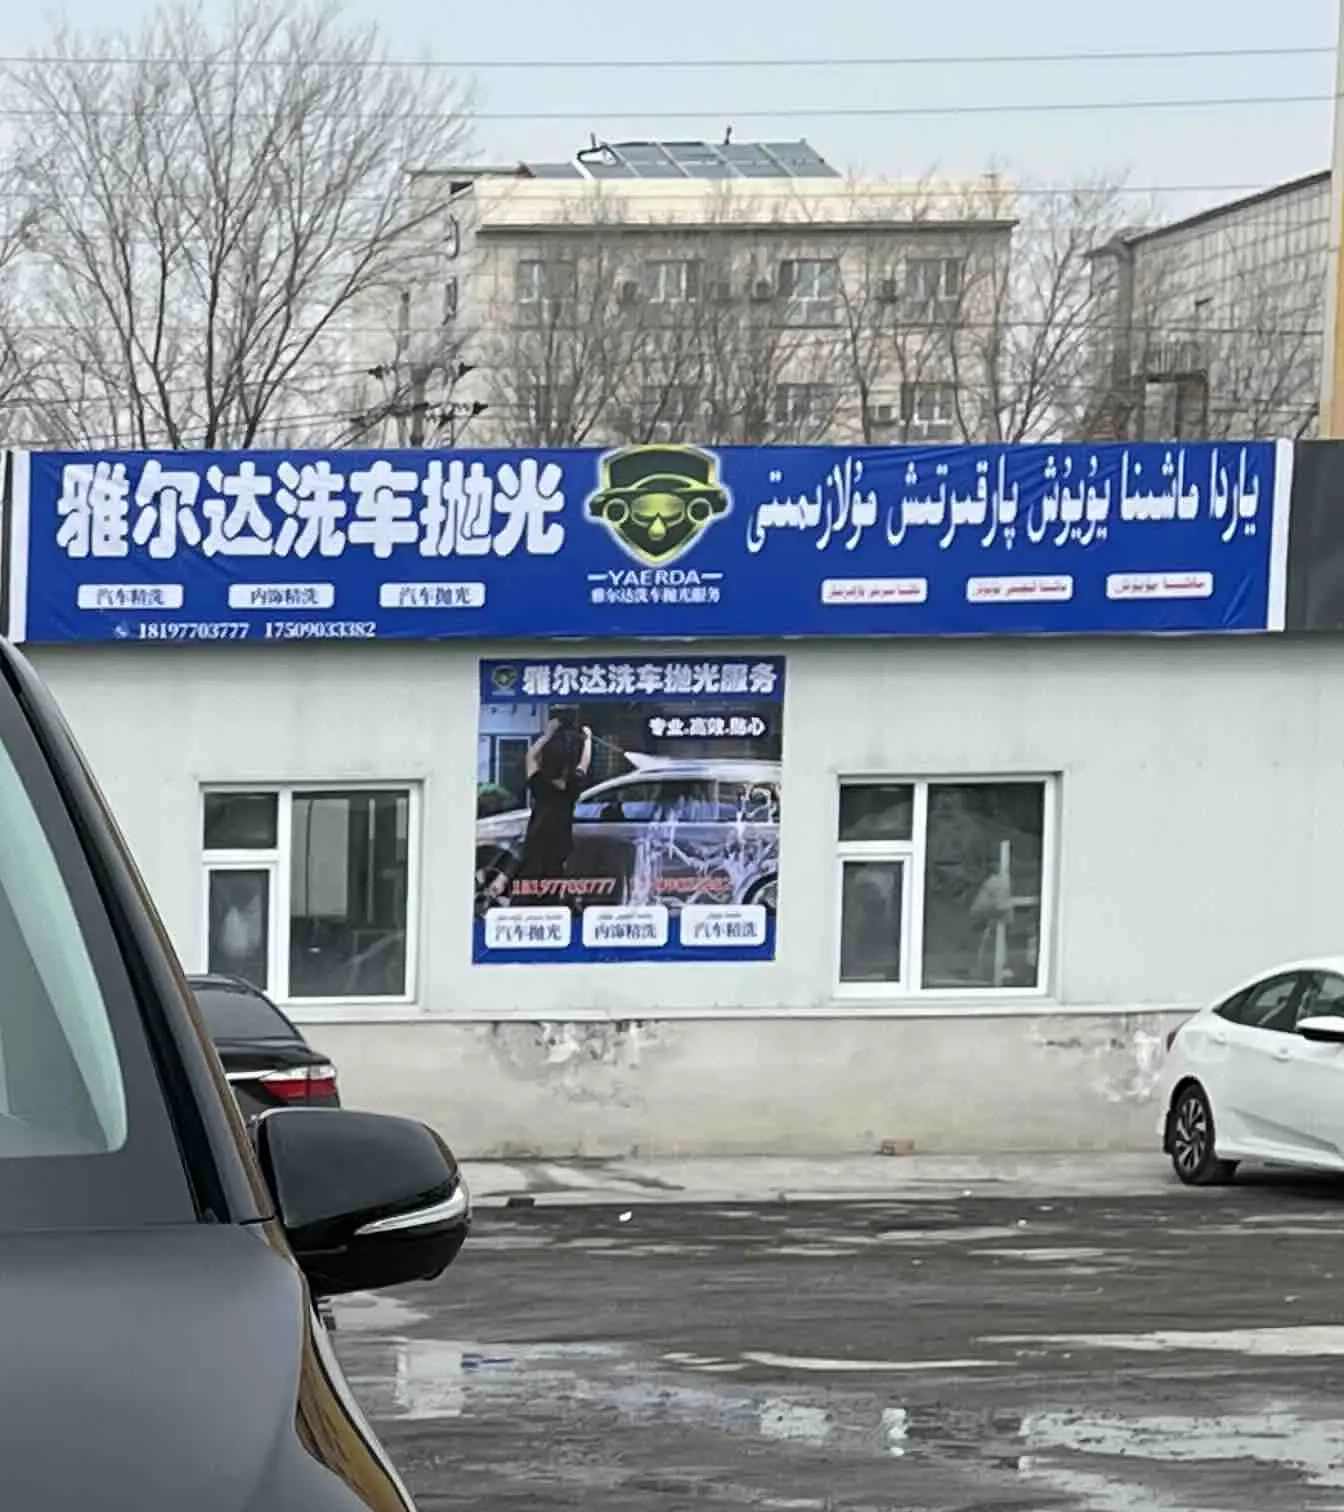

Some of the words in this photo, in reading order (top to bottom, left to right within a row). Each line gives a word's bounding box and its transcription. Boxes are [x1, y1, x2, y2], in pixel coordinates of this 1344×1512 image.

[56, 458, 564, 559] 雅尔达洗车抛光
[607, 569, 701, 586] YAERDA
[139, 622, 250, 639] 18197703777
[522, 663, 777, 696] 雅尔达洗车抛光服务
